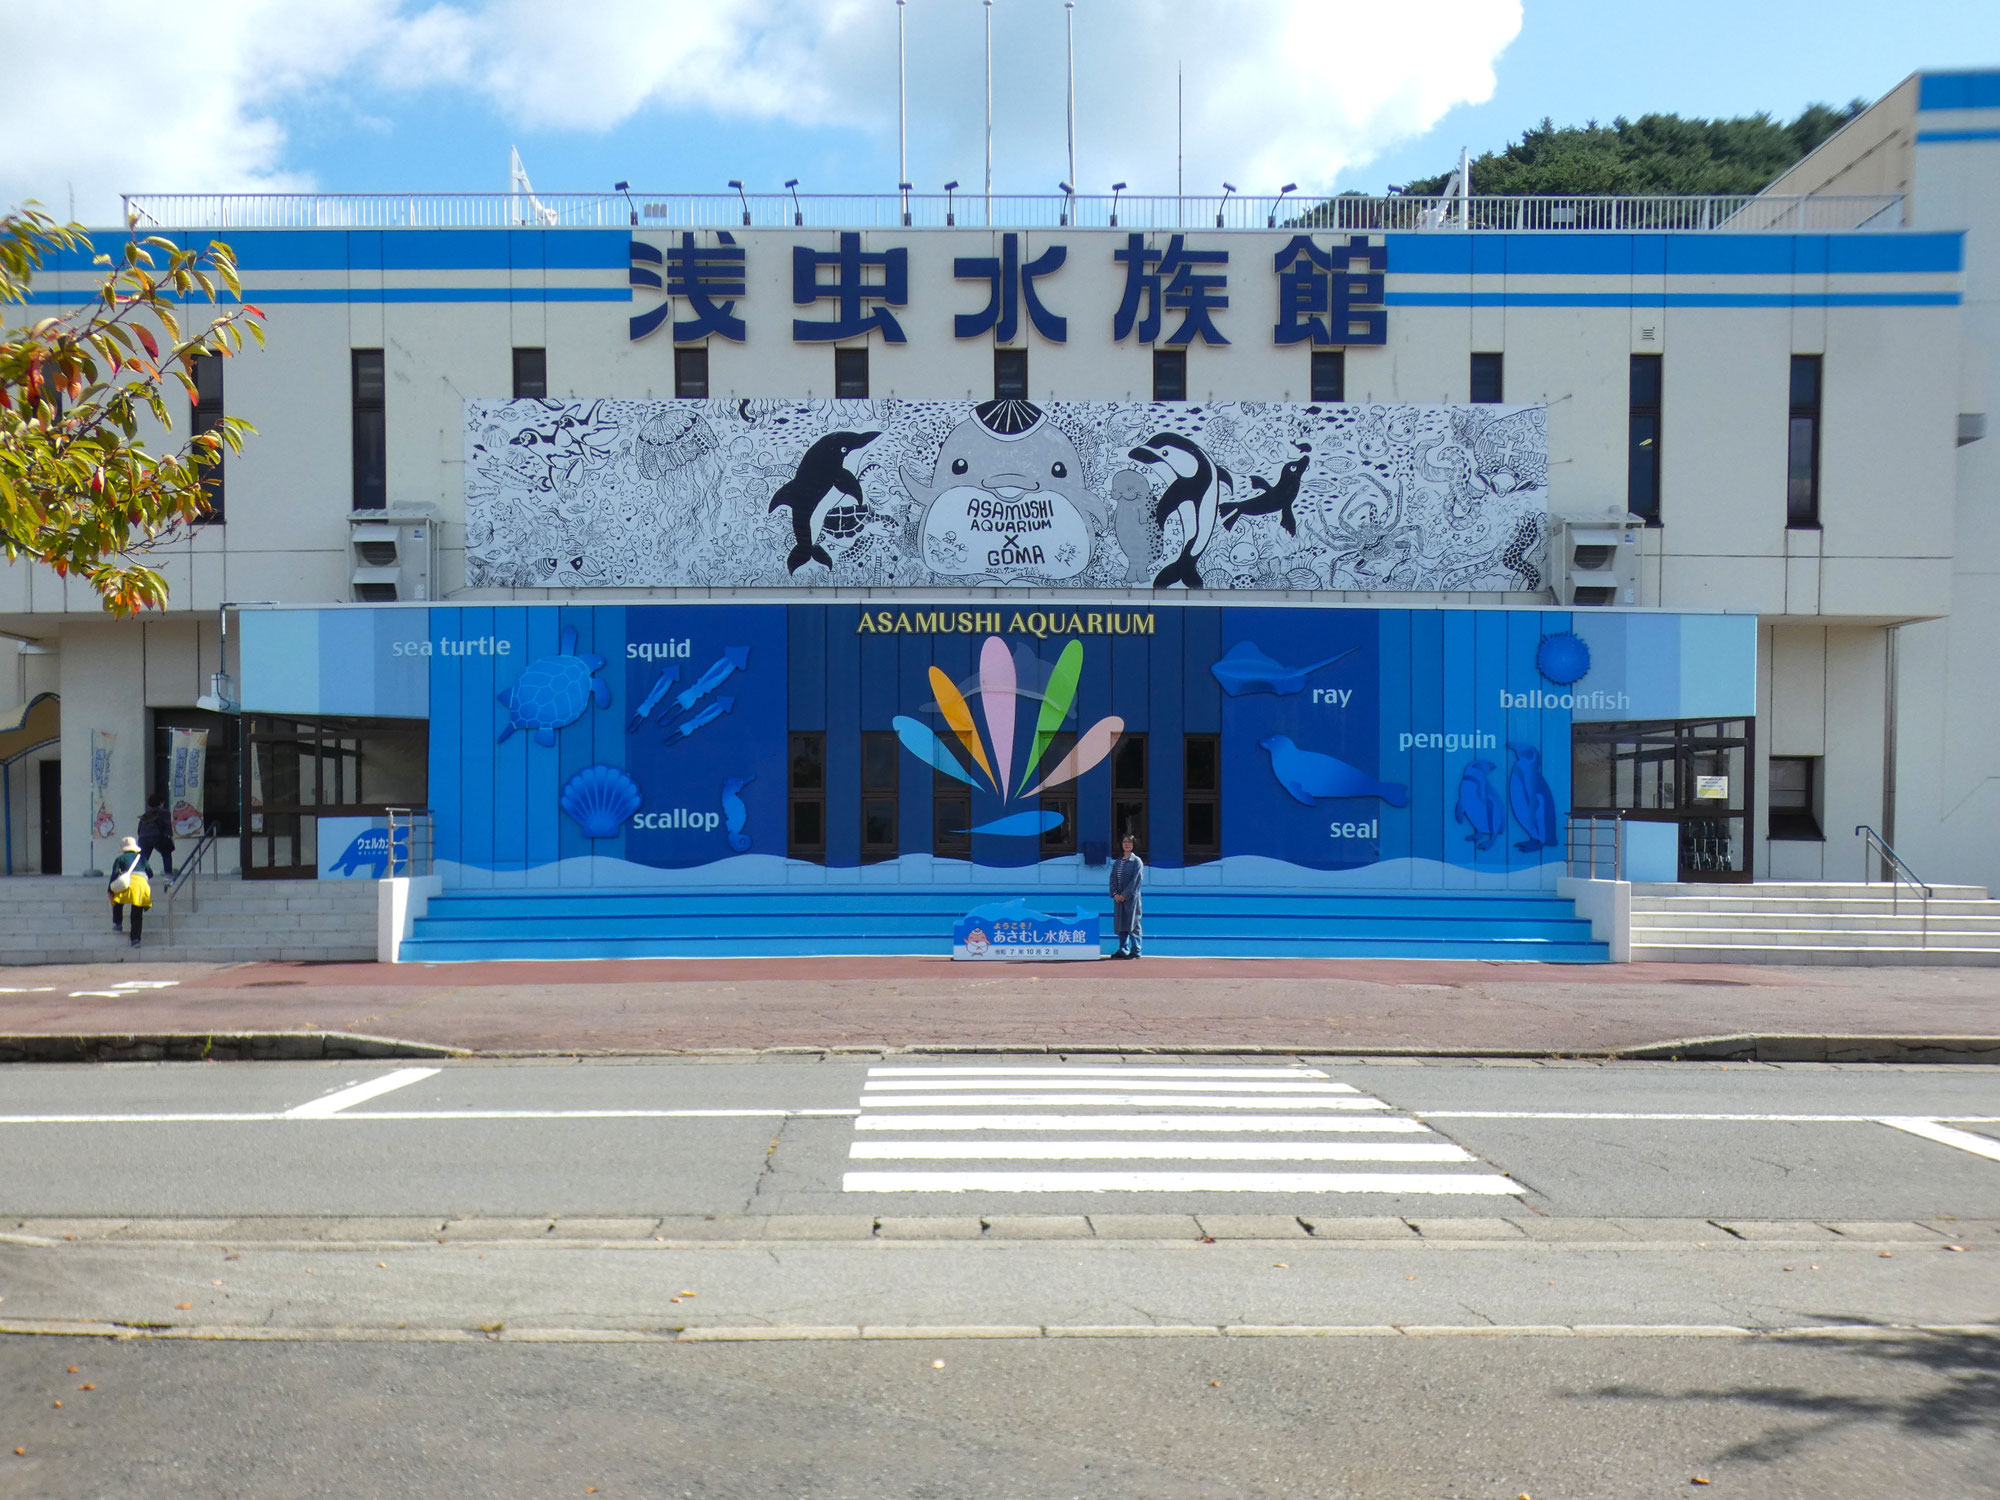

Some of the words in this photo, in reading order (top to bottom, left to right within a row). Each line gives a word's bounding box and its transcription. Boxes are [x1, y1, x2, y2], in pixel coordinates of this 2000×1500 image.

[629, 231, 1388, 346] 浅虫水族館
[966, 498, 1054, 521] ASAMUSHI
[969, 519, 1052, 533] AQUARIUM
[987, 545, 1046, 566] GOMA
[857, 612, 1001, 633] ASAMUSHI
[1008, 612, 1156, 638] AQUARIUM
[392, 639, 433, 656] sea
[440, 636, 511, 656] turtle
[626, 638, 691, 661] squid
[1311, 688, 1353, 708] ray
[1500, 689, 1631, 710] balloonfish
[1399, 729, 1497, 753] penguin
[633, 808, 720, 832] scallop
[1330, 819, 1378, 839] seal
[993, 930, 1086, 943] あさむし水族館
